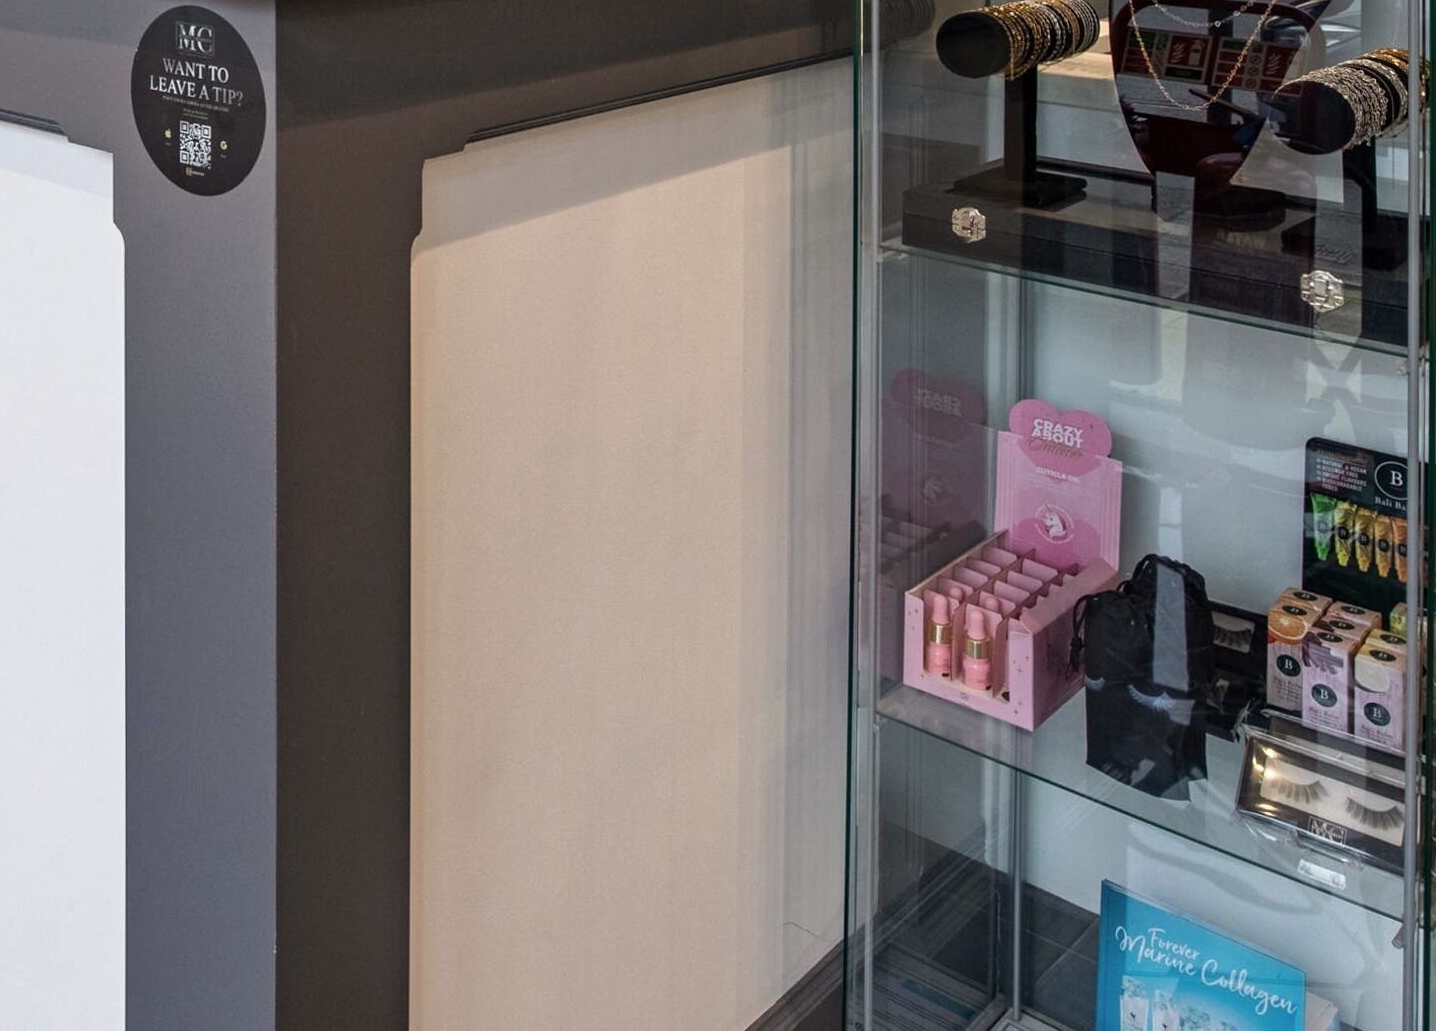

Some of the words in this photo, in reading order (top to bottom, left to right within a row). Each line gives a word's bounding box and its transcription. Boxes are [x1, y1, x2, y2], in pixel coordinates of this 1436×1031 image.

[179, 24, 213, 53] MC
[163, 57, 206, 80] WANT
[208, 65, 229, 84] TO
[150, 75, 196, 98] LEAVE
[199, 84, 209, 100] A
[212, 86, 243, 106] TIP?
[1031, 428, 1083, 448] ABOUT
[1034, 418, 1083, 440] CRAZY
[1390, 470, 1403, 486] B
[1375, 497, 1392, 507] Bali
[1395, 502, 1406, 510] Ba
[1148, 927, 1200, 960] Forever
[1115, 926, 1196, 976] Marine
[1201, 959, 1297, 1015] Collagen
